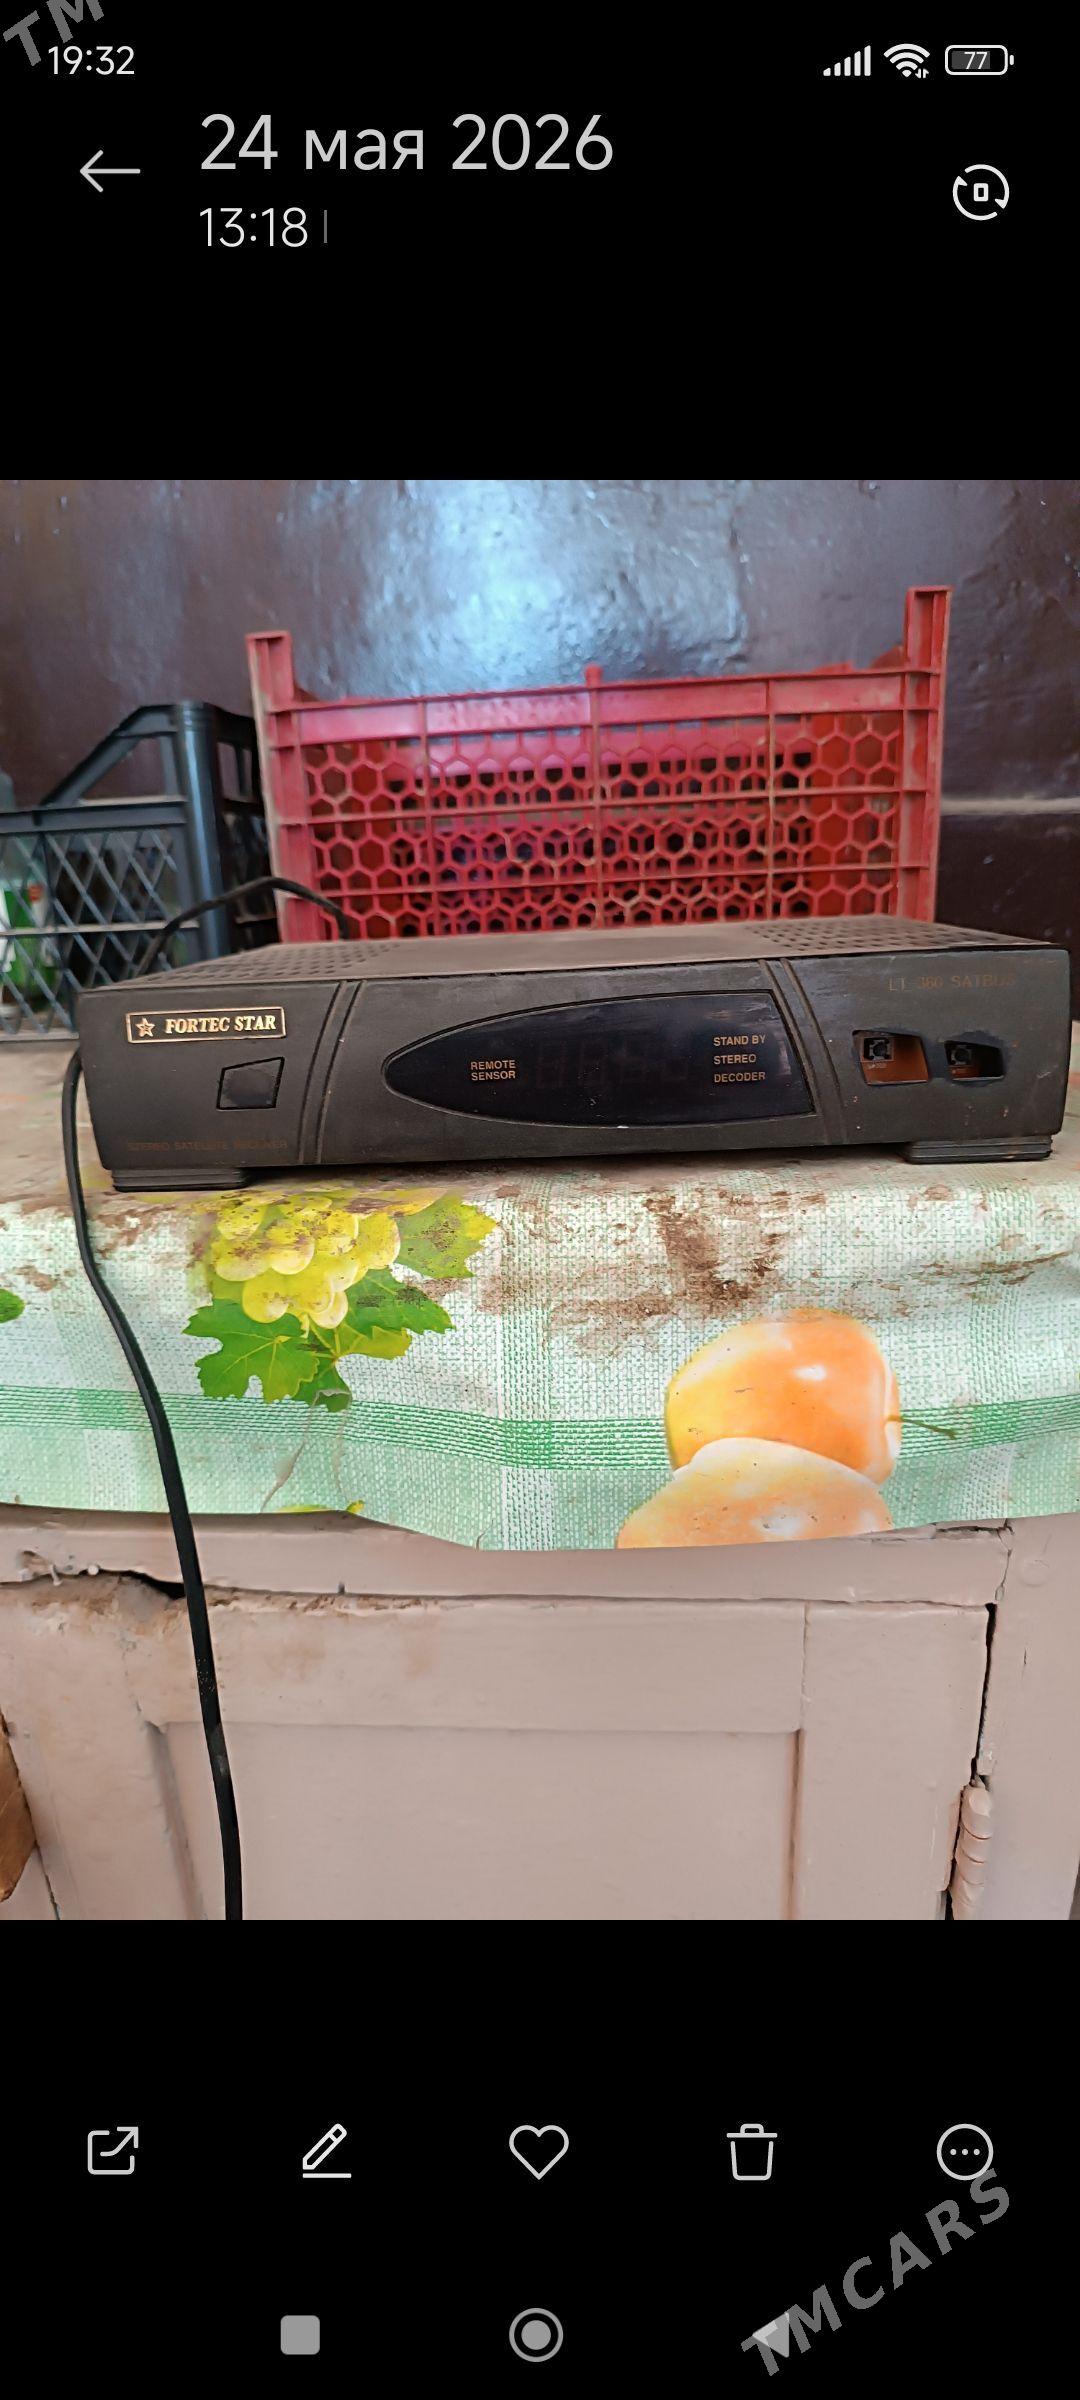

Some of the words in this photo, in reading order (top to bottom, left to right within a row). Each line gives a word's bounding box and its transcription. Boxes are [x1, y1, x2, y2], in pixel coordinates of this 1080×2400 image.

[48, 46, 135, 75] 19:32
[964, 52, 987, 69] 77
[200, 114, 279, 170] 24
[306, 128, 424, 171] мая
[452, 113, 614, 171] 2026
[200, 207, 308, 248] 13:18
[165, 1017, 231, 1034] FORTEC
[234, 1015, 277, 1031] STAR
[713, 1035, 749, 1047] STAND
[751, 1034, 766, 1045] BY
[470, 1059, 516, 1071] REMOTE
[713, 1053, 757, 1065] STEREO
[471, 1070, 516, 1081] SENSOR
[713, 1071, 766, 1083] DECODER
